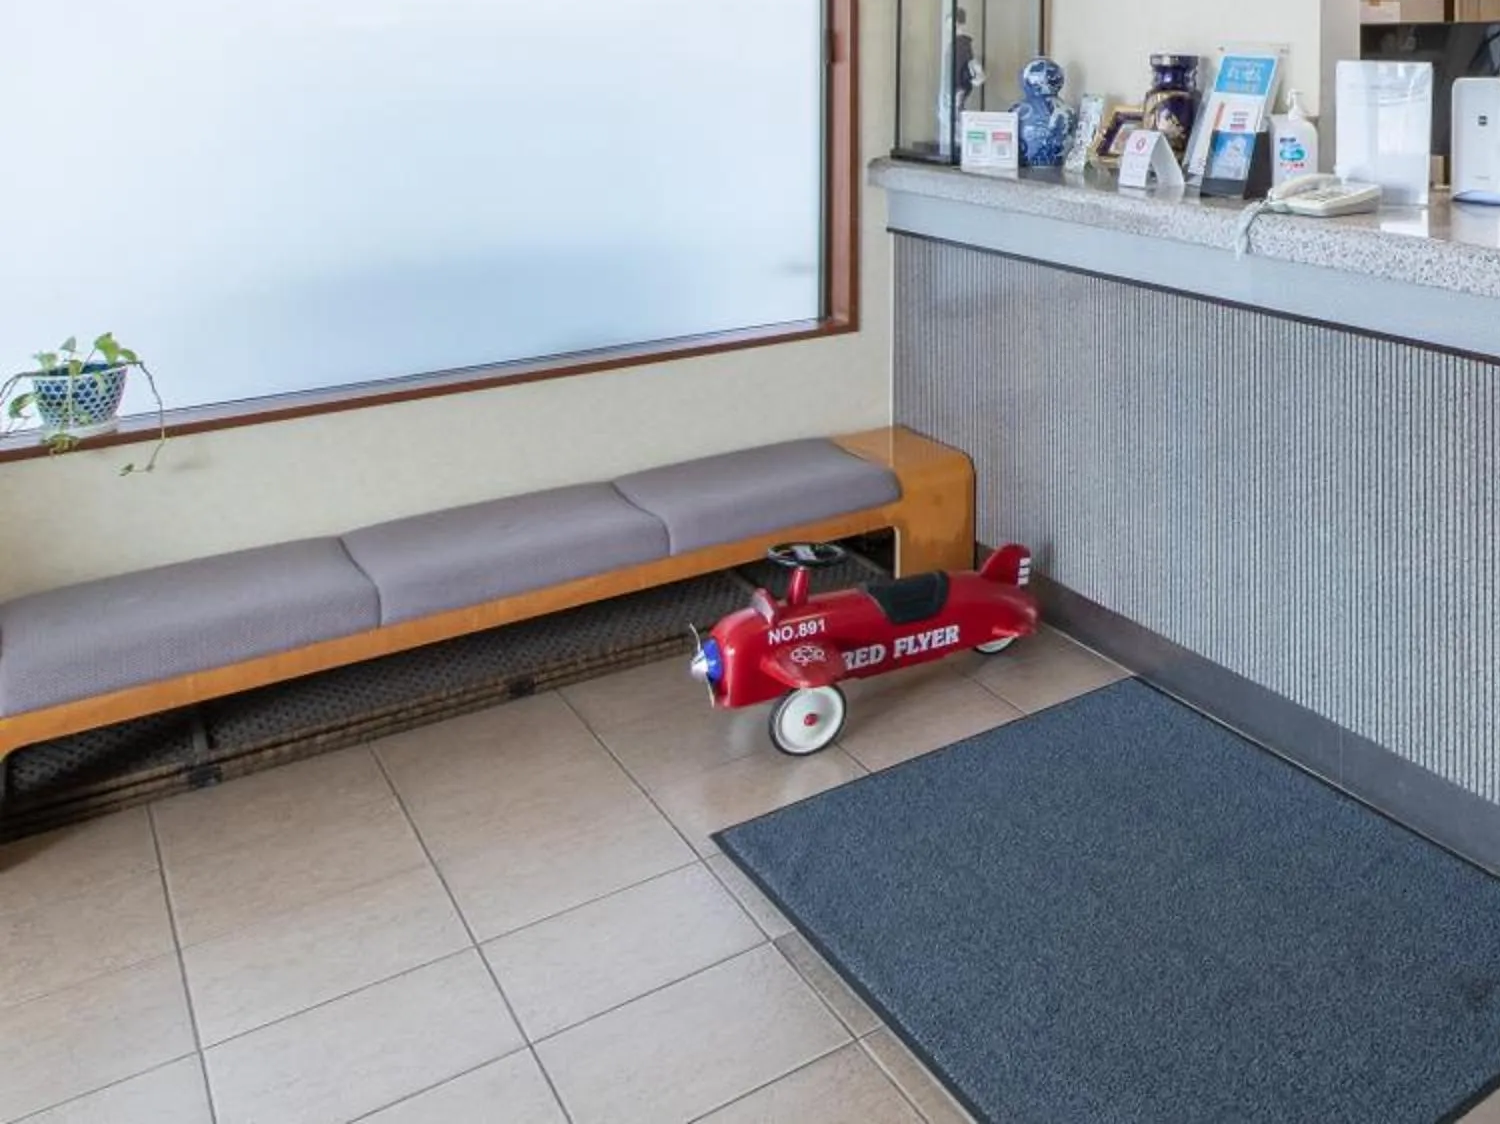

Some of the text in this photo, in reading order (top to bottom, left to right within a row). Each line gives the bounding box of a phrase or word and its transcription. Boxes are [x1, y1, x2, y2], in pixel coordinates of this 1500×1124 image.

[768, 618, 826, 645] NO.891
[841, 644, 886, 670] RED
[893, 626, 960, 658] FLYER
